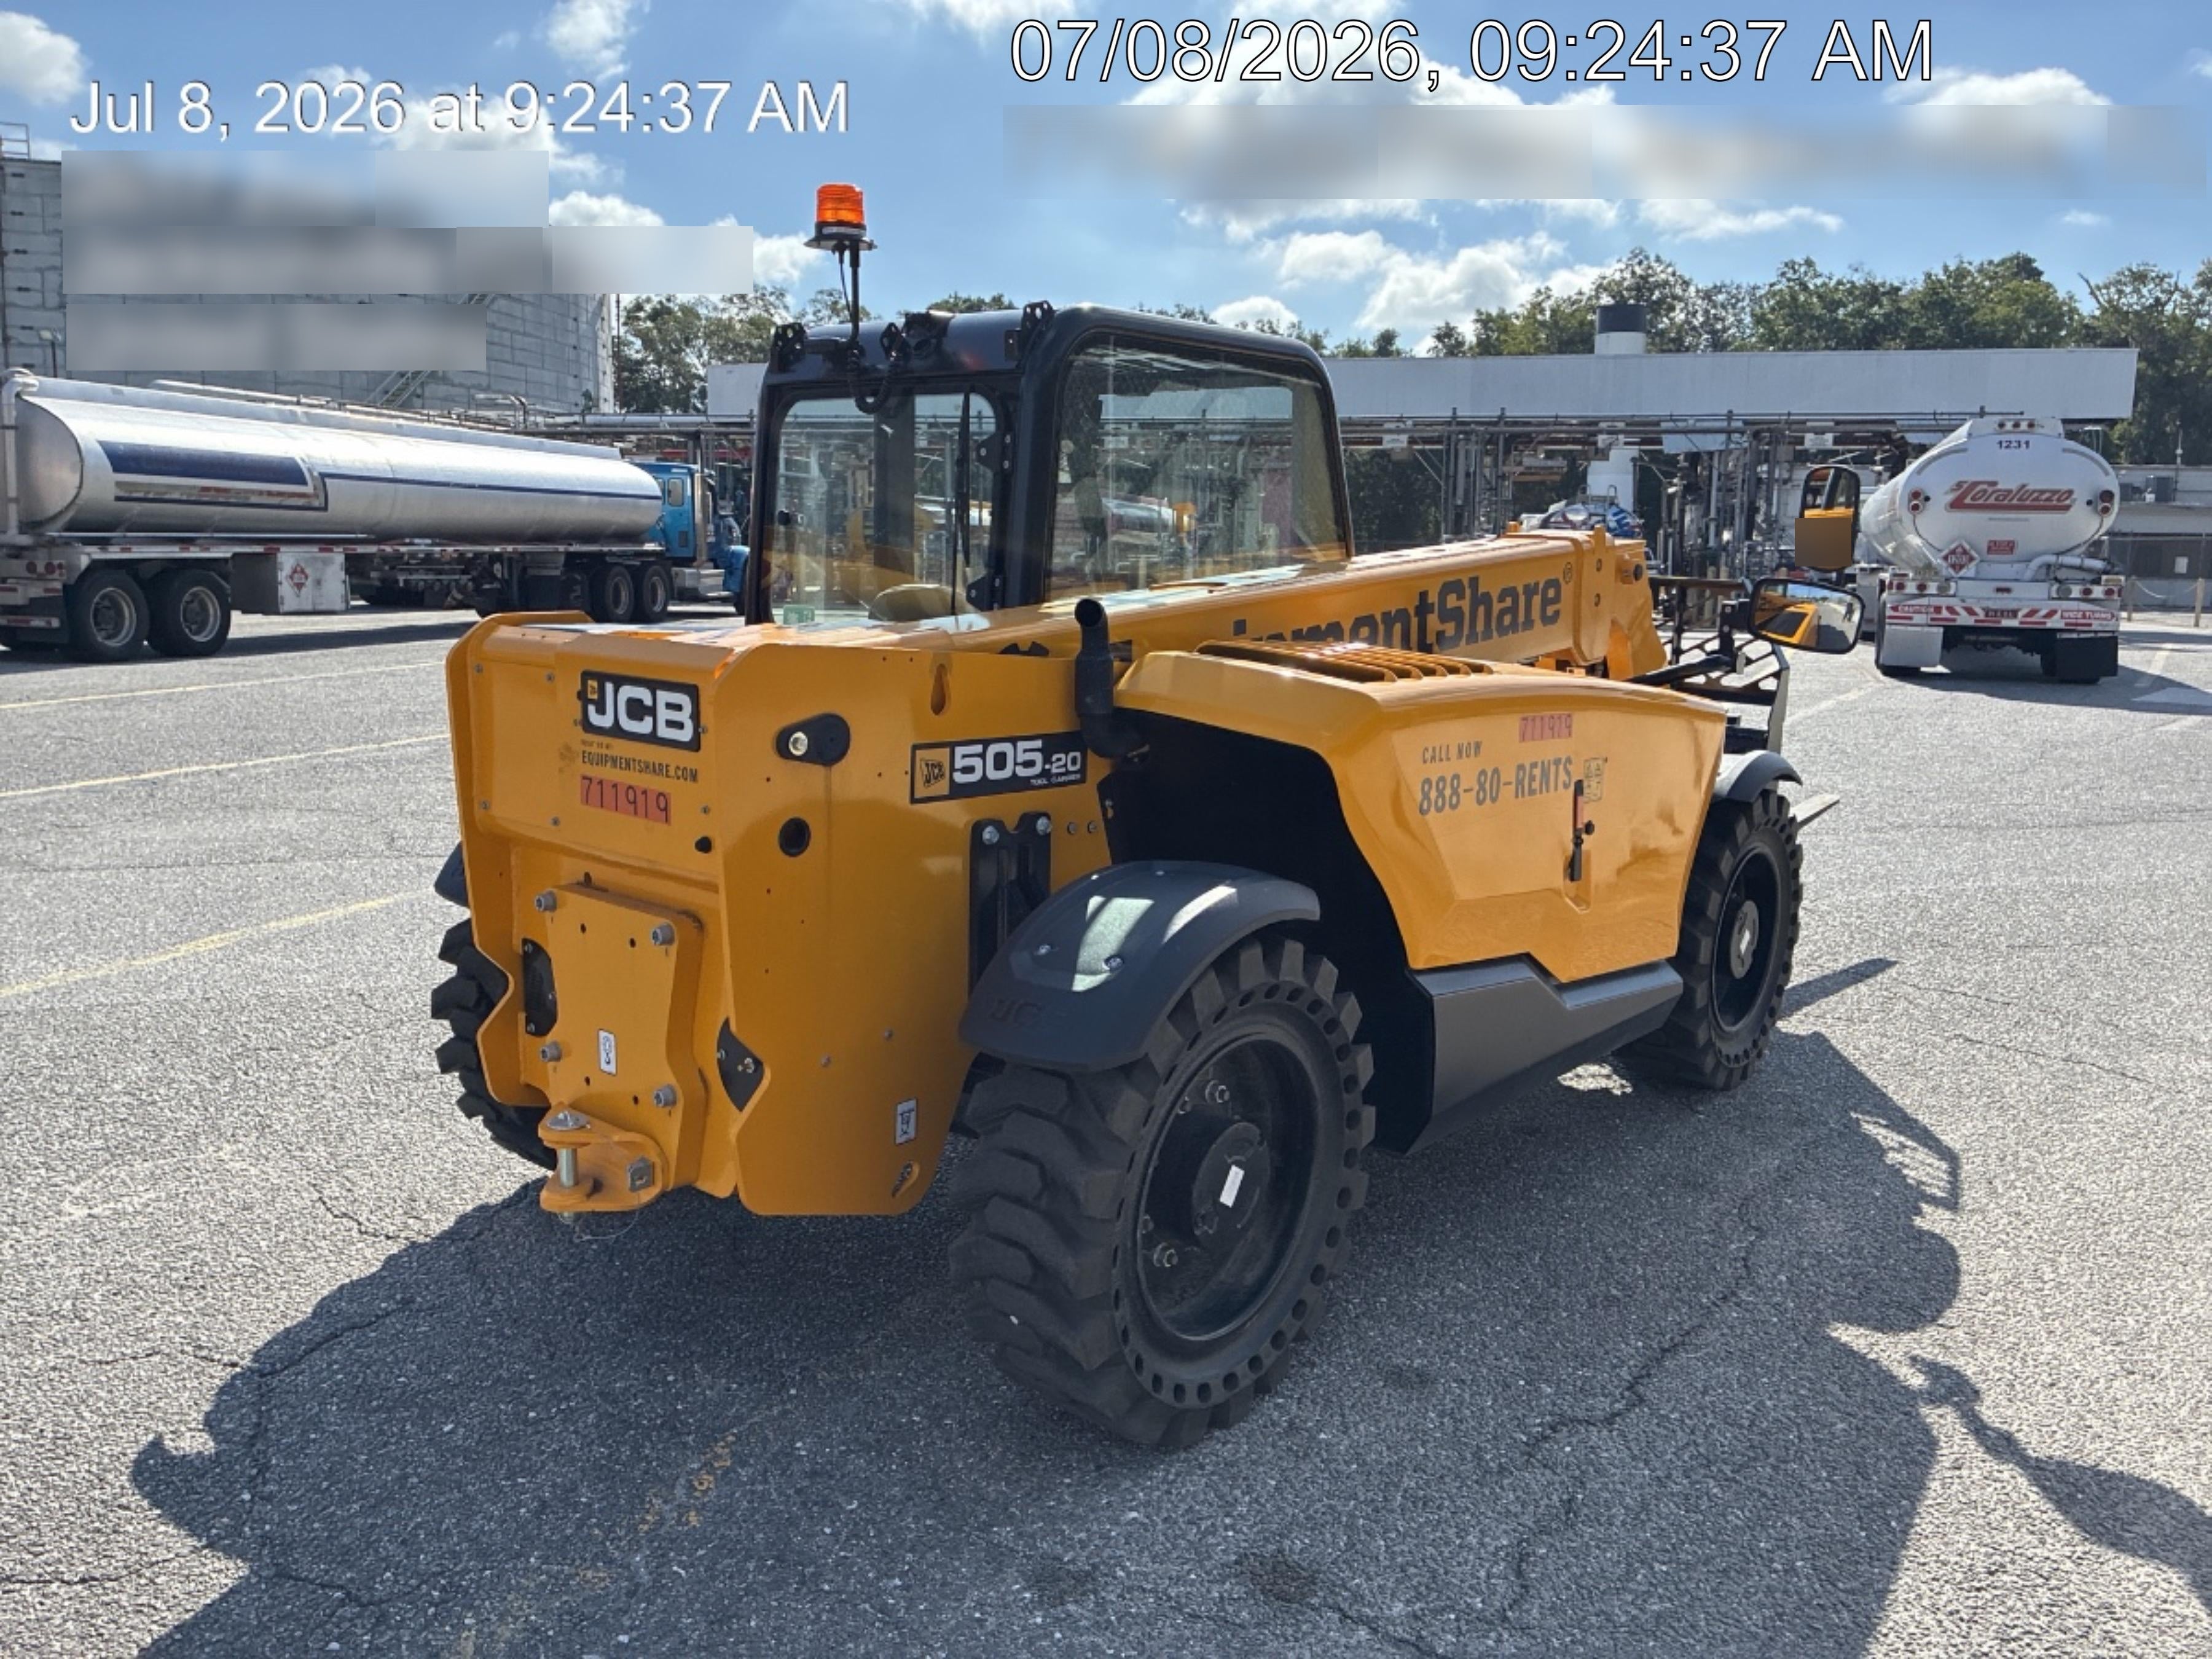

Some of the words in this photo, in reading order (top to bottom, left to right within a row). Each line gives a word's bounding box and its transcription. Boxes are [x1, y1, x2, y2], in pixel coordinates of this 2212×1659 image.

[1996, 440, 2031, 450] 1231
[587, 681, 695, 742] JCB
[1520, 714, 1572, 742] 711919
[581, 750, 699, 783] EQUIPMENTSHARE.COM
[1422, 744, 1451, 764] CALL
[1456, 740, 1483, 760] NOW
[581, 775, 669, 824] 711919
[1419, 755, 1573, 816] 888-80-RENTS
